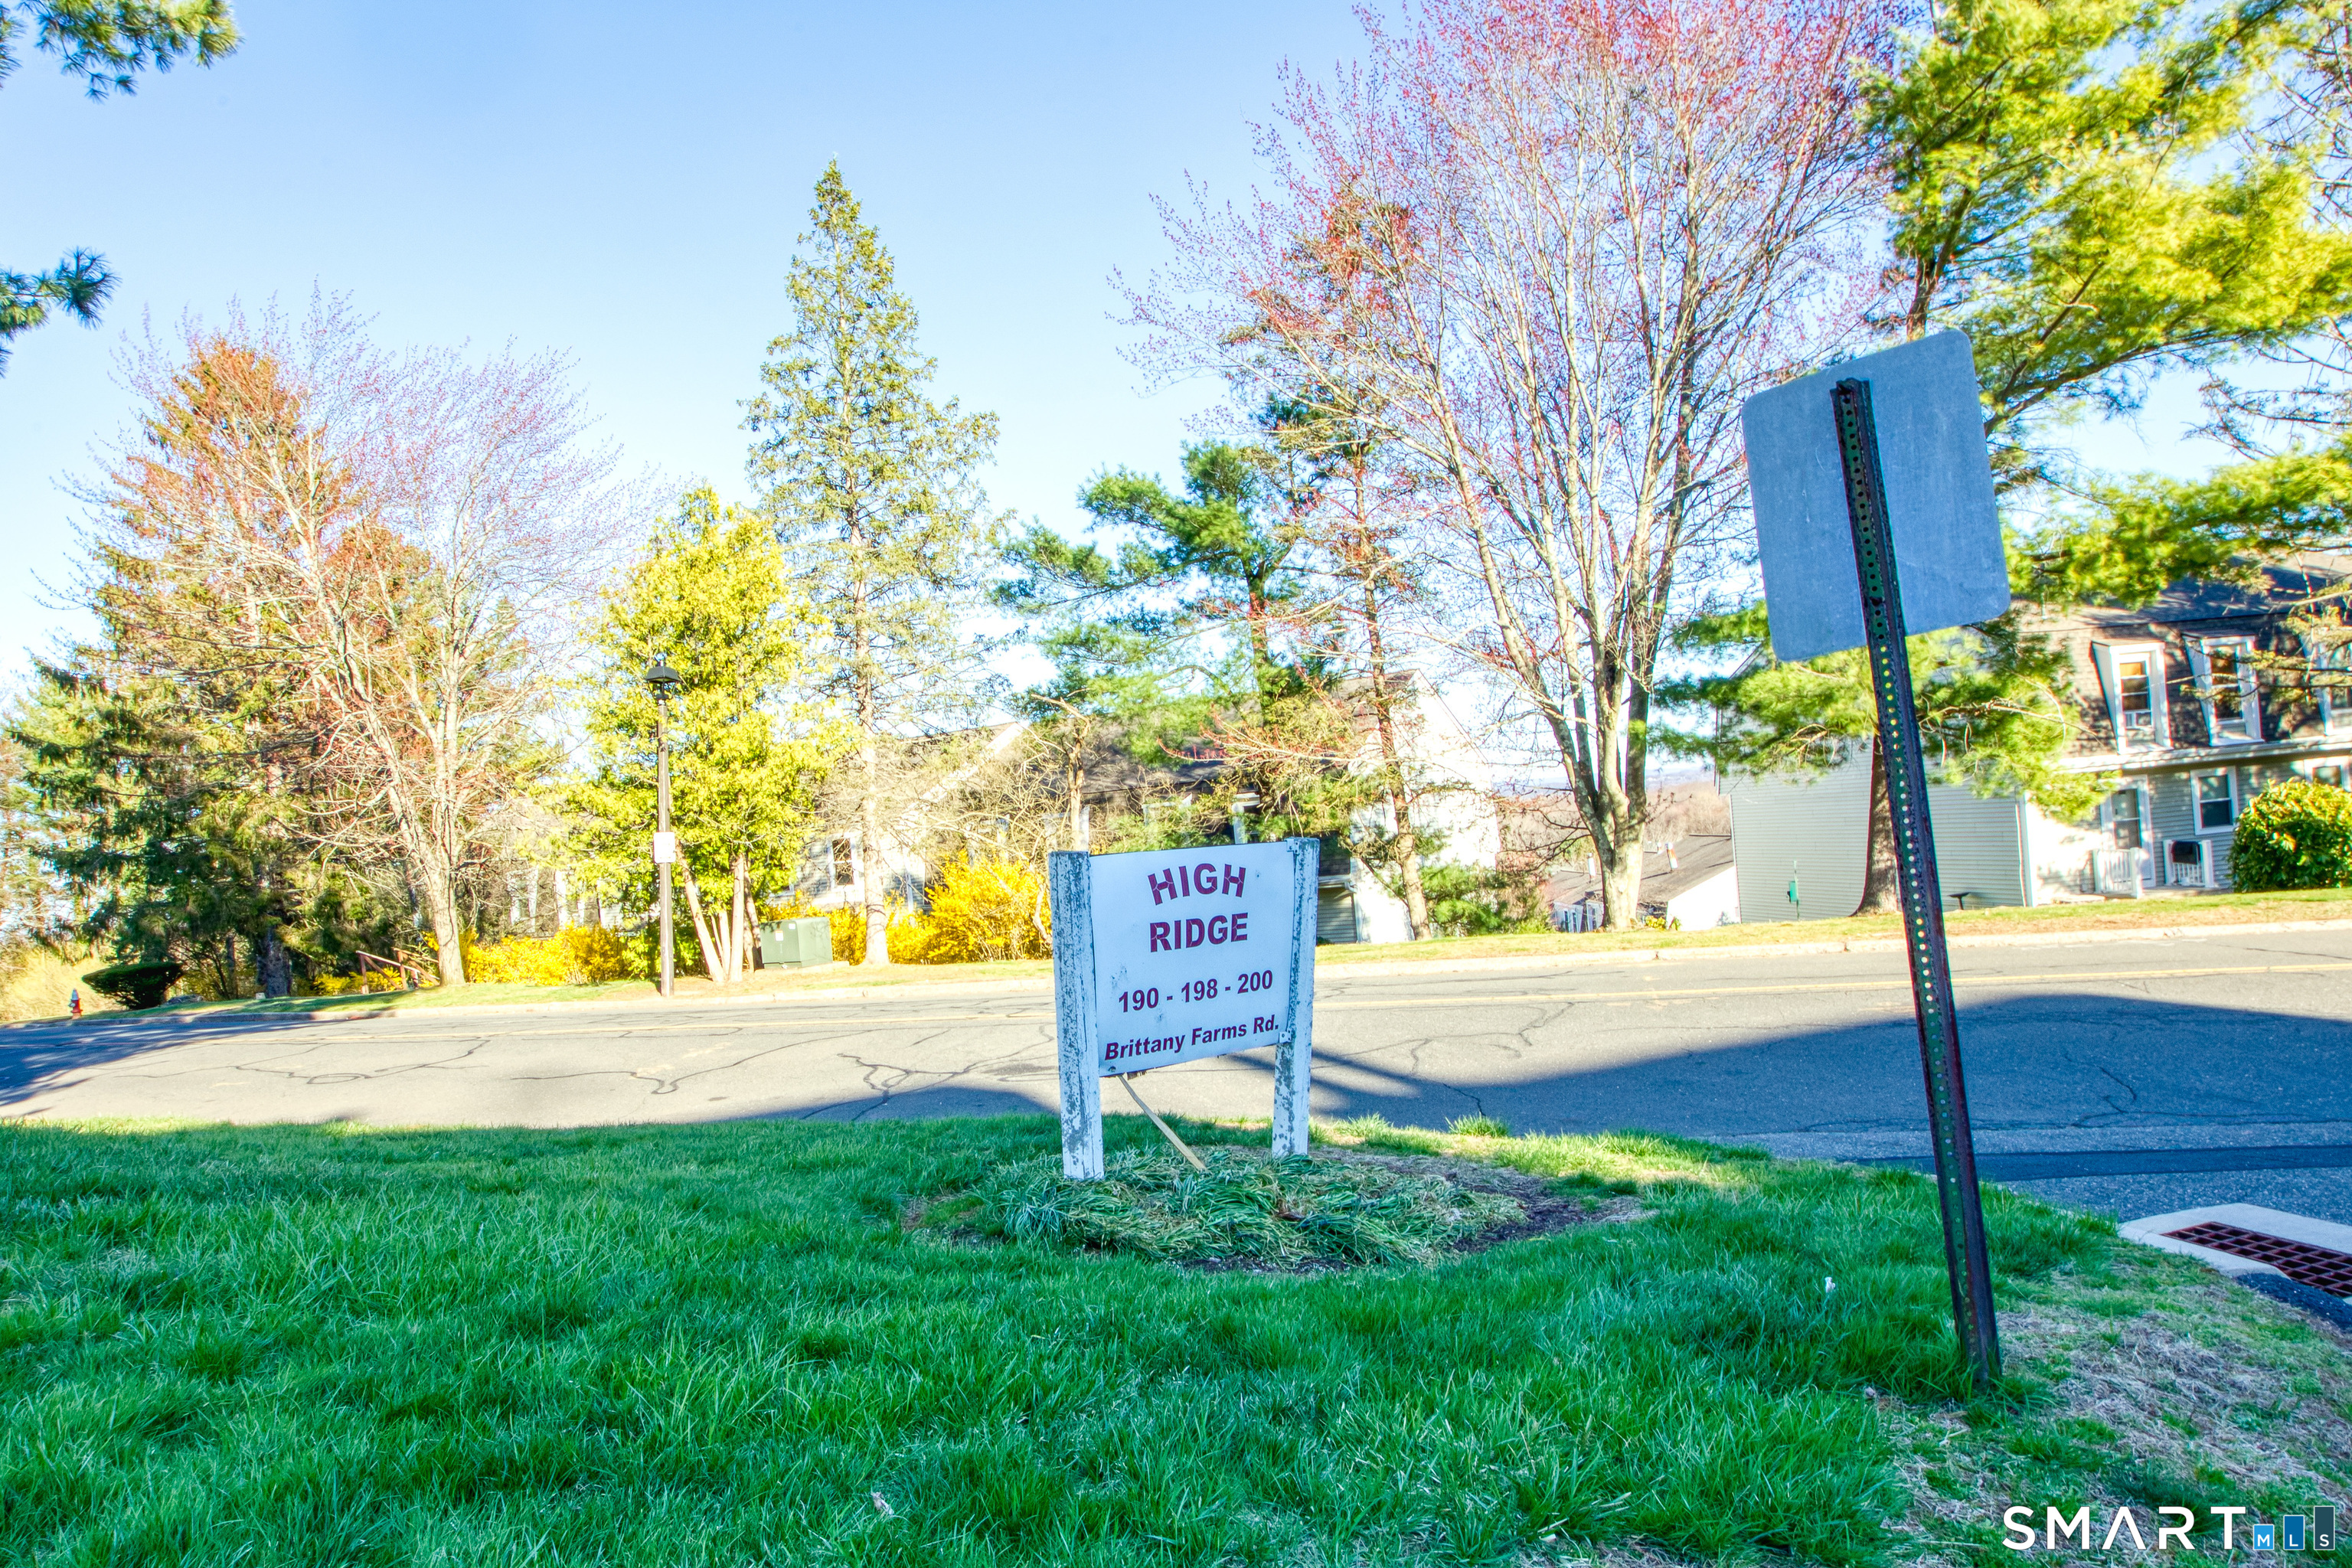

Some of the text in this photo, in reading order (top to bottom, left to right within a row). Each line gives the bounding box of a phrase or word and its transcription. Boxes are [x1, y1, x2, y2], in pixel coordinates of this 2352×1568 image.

[1148, 863, 1246, 906] HIGH
[1150, 912, 1249, 952] RIDGE
[1118, 988, 1159, 1013] 190
[1181, 978, 1218, 1003] 198
[1237, 970, 1273, 995] 200
[1104, 1014, 1279, 1061] Brittany Farms Rd.
